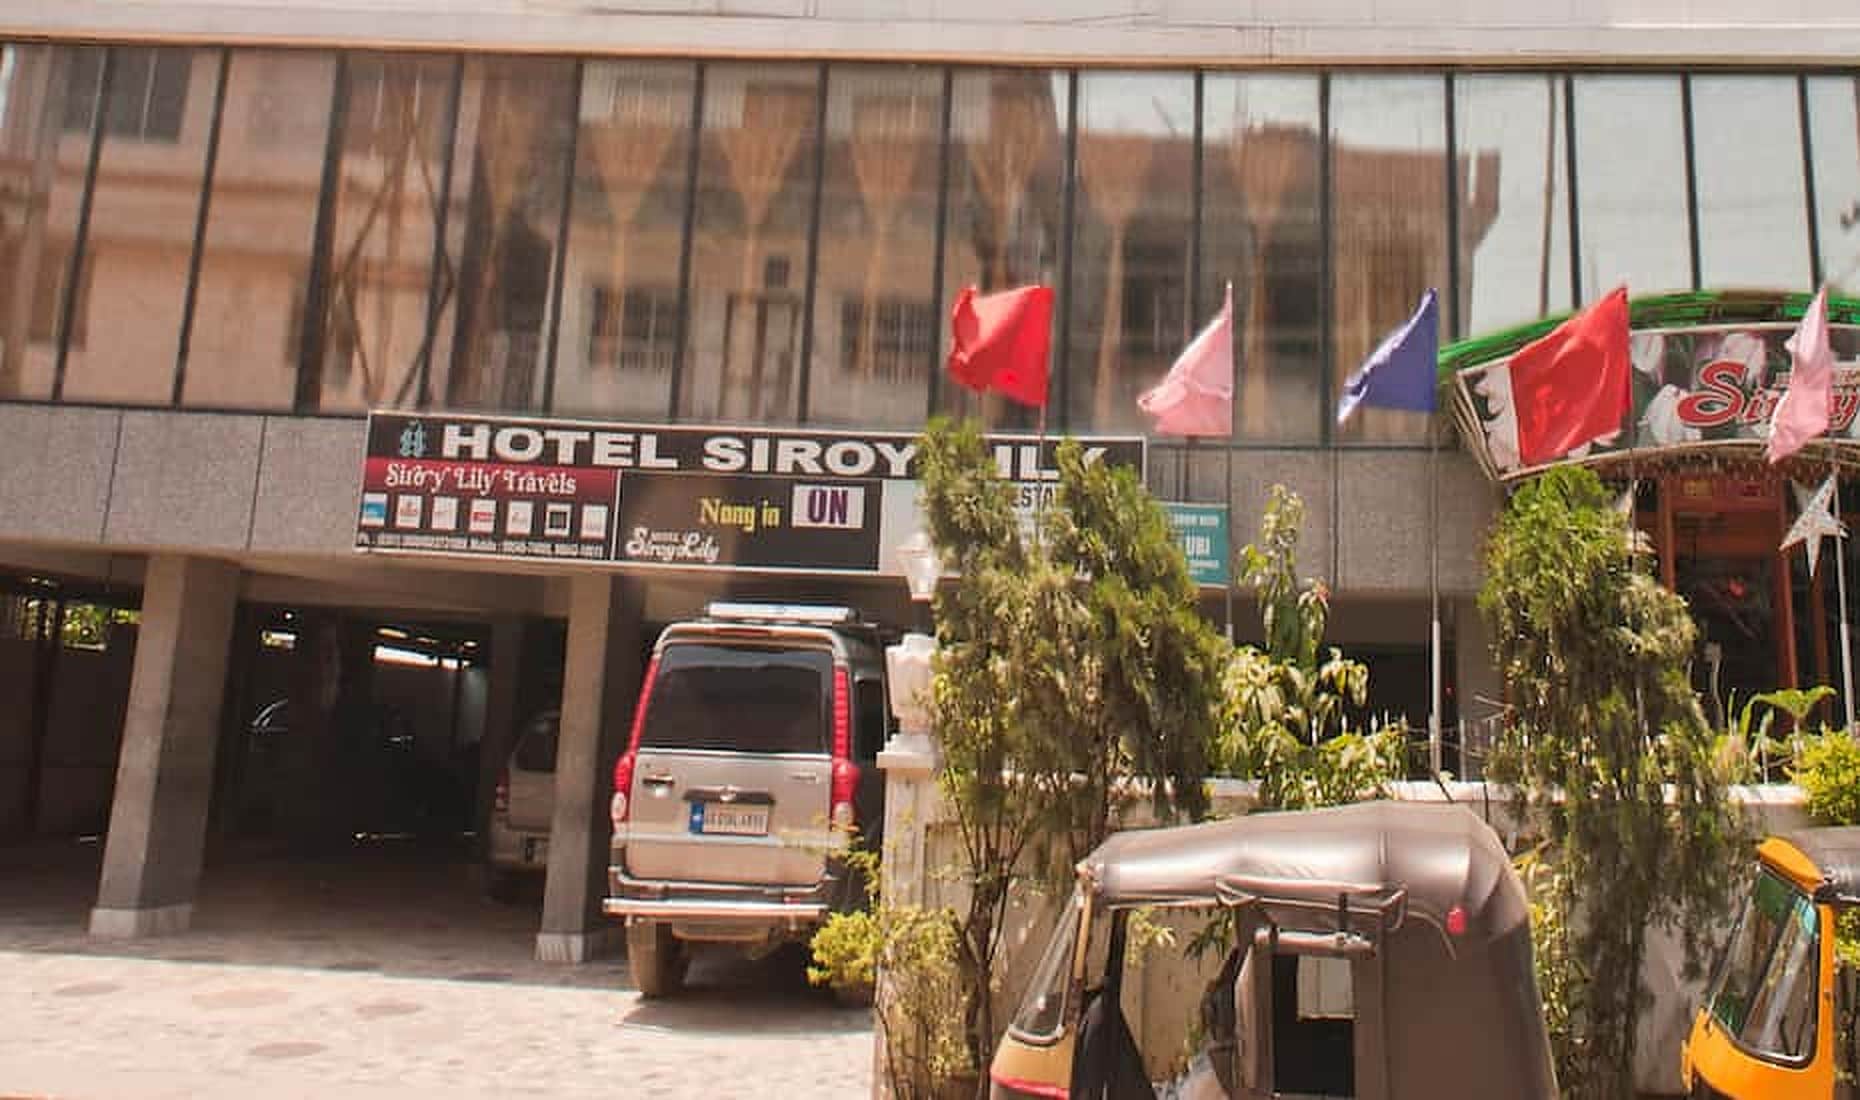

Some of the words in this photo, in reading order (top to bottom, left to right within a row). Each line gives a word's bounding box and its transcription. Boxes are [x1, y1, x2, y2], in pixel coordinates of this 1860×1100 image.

[442, 423, 678, 469] HOTEL
[702, 436, 917, 478] SIROY
[385, 463, 451, 494] Siroy
[454, 466, 500, 496] Lily
[502, 469, 577, 495] Travels
